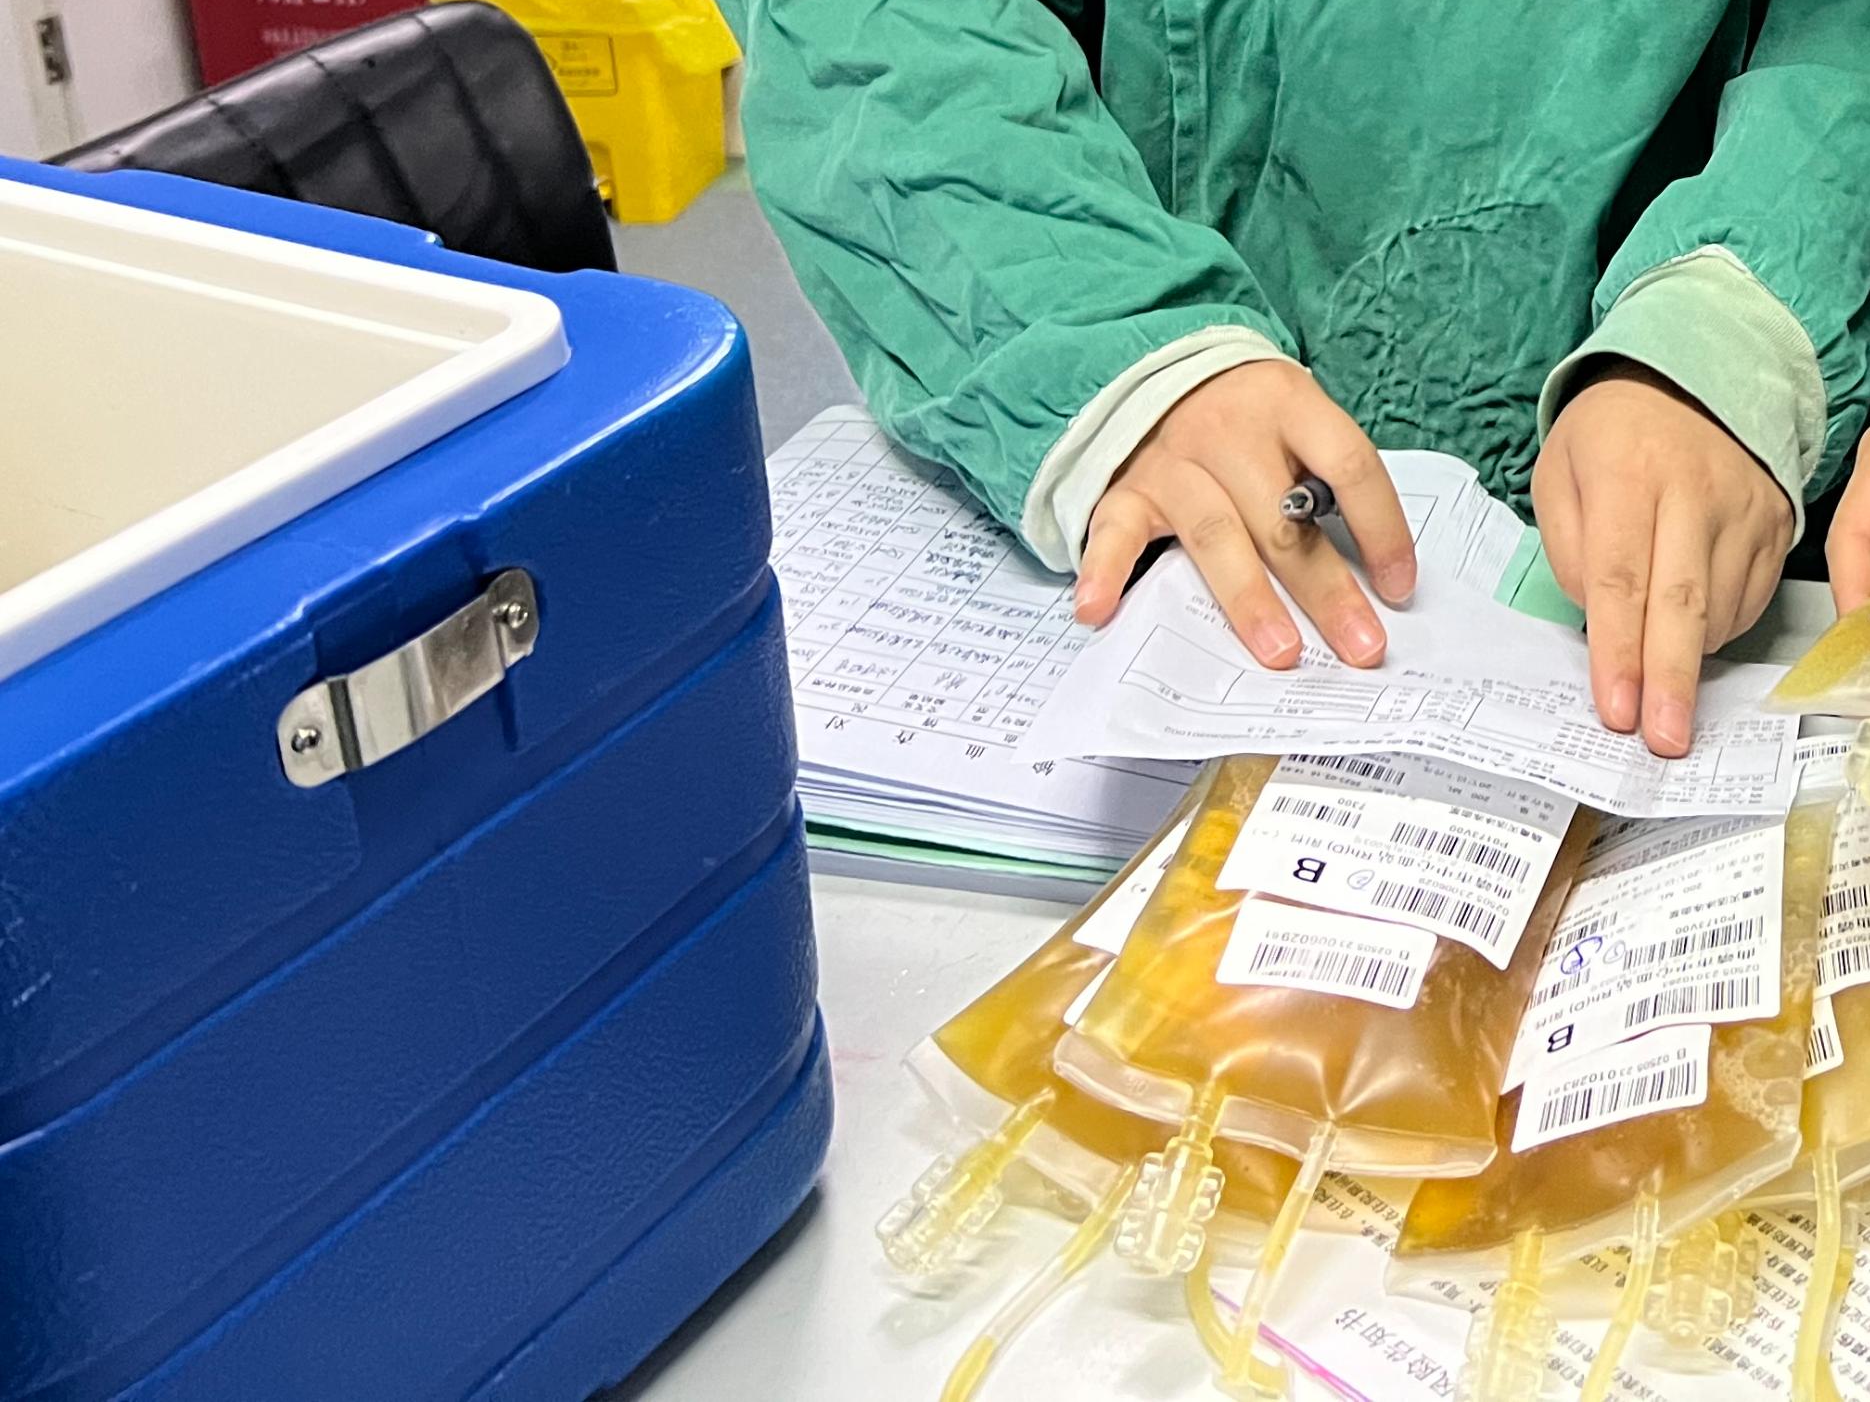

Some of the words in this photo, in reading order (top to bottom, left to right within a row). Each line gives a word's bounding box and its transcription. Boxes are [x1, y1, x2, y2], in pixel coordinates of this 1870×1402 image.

[1292, 856, 1328, 885] B
[1546, 1023, 1575, 1054] B
[1334, 1301, 1460, 1401] 风险告知书
